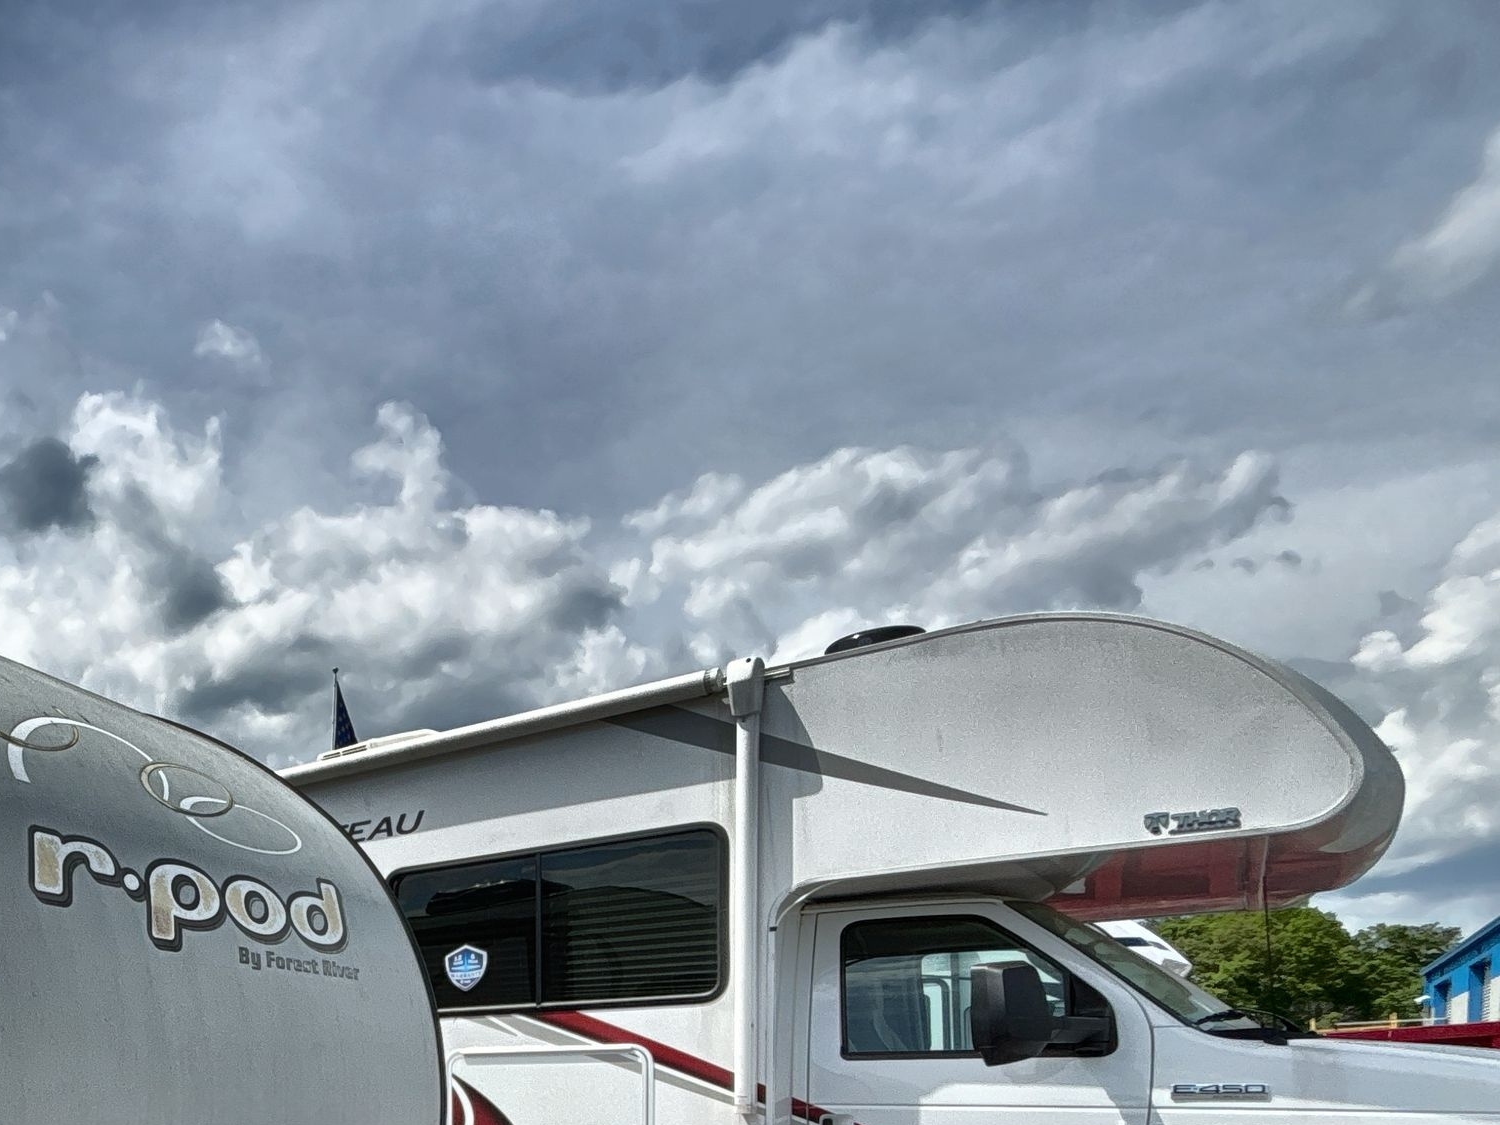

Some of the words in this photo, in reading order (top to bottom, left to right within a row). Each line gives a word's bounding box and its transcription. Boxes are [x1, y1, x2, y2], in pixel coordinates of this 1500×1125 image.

[1171, 807, 1242, 828] THOR
[238, 946, 262, 971] By
[266, 950, 320, 975] Forest
[322, 959, 360, 981] River
